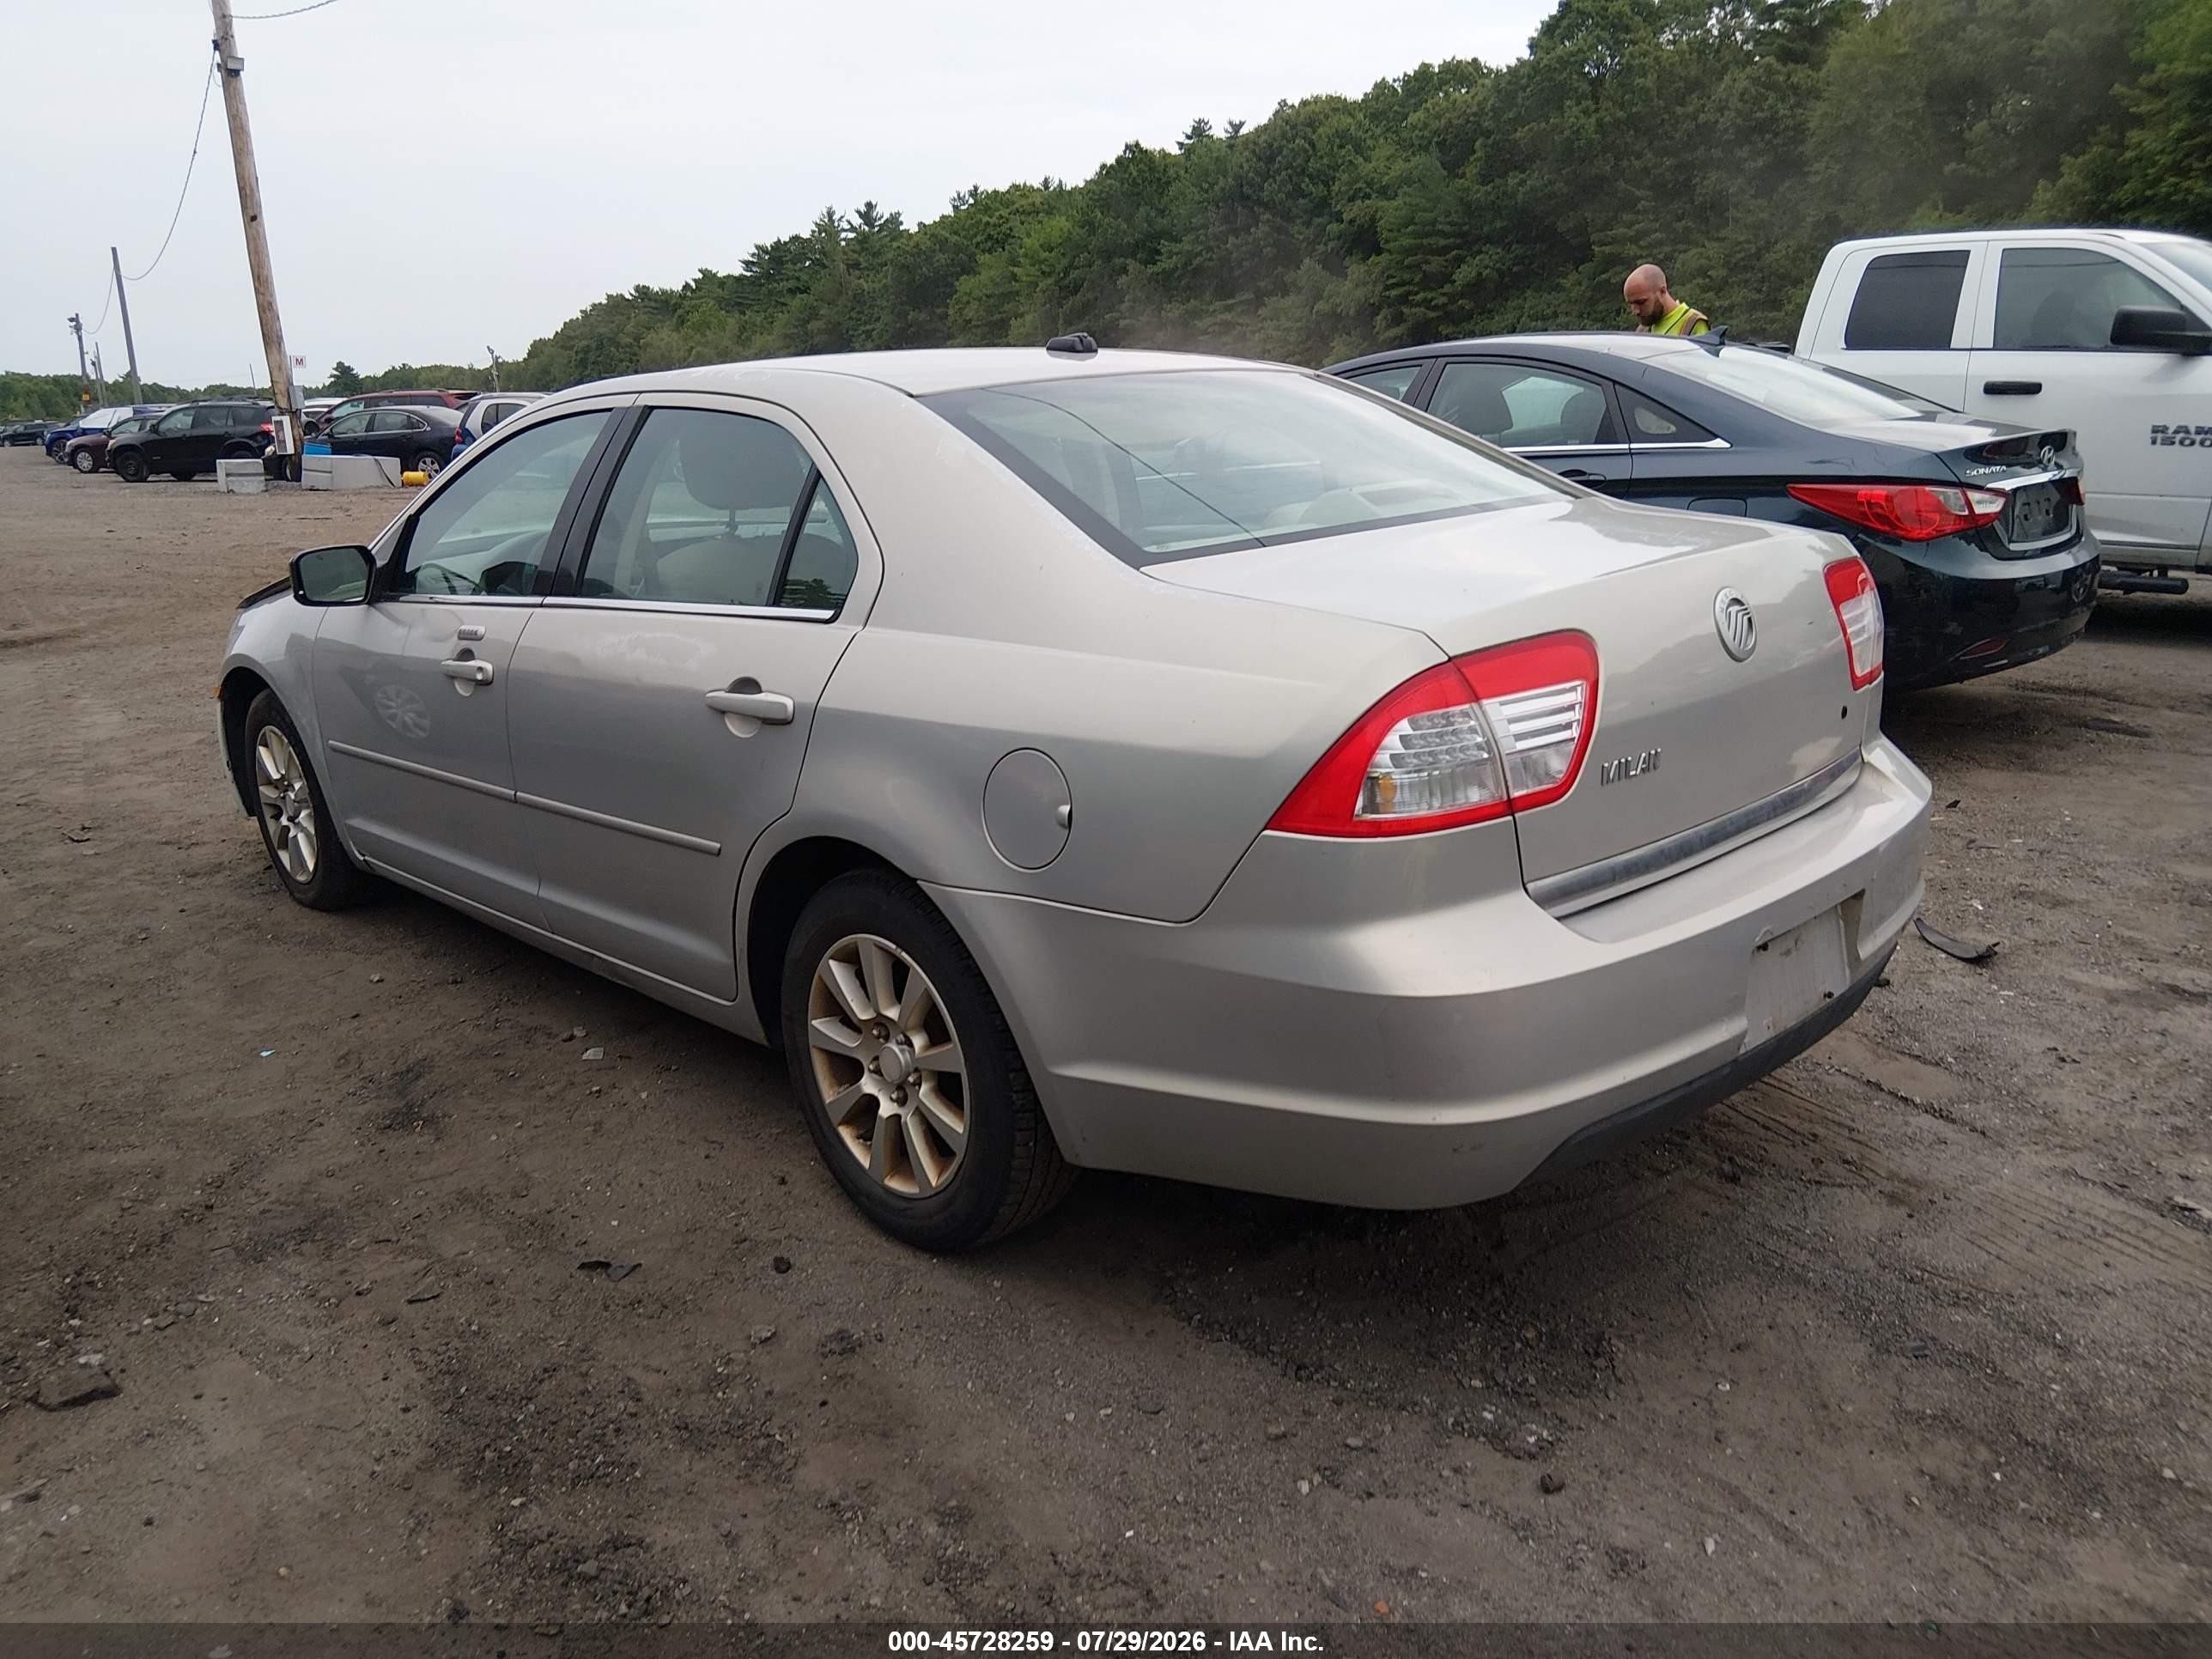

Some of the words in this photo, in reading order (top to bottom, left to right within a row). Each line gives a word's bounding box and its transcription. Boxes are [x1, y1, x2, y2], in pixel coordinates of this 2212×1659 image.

[295, 357, 304, 366] M
[2150, 424, 2212, 435] RAM
[2149, 434, 2212, 447] 1500
[1965, 465, 2007, 477] SONATA
[1601, 747, 1662, 787] MILAN
